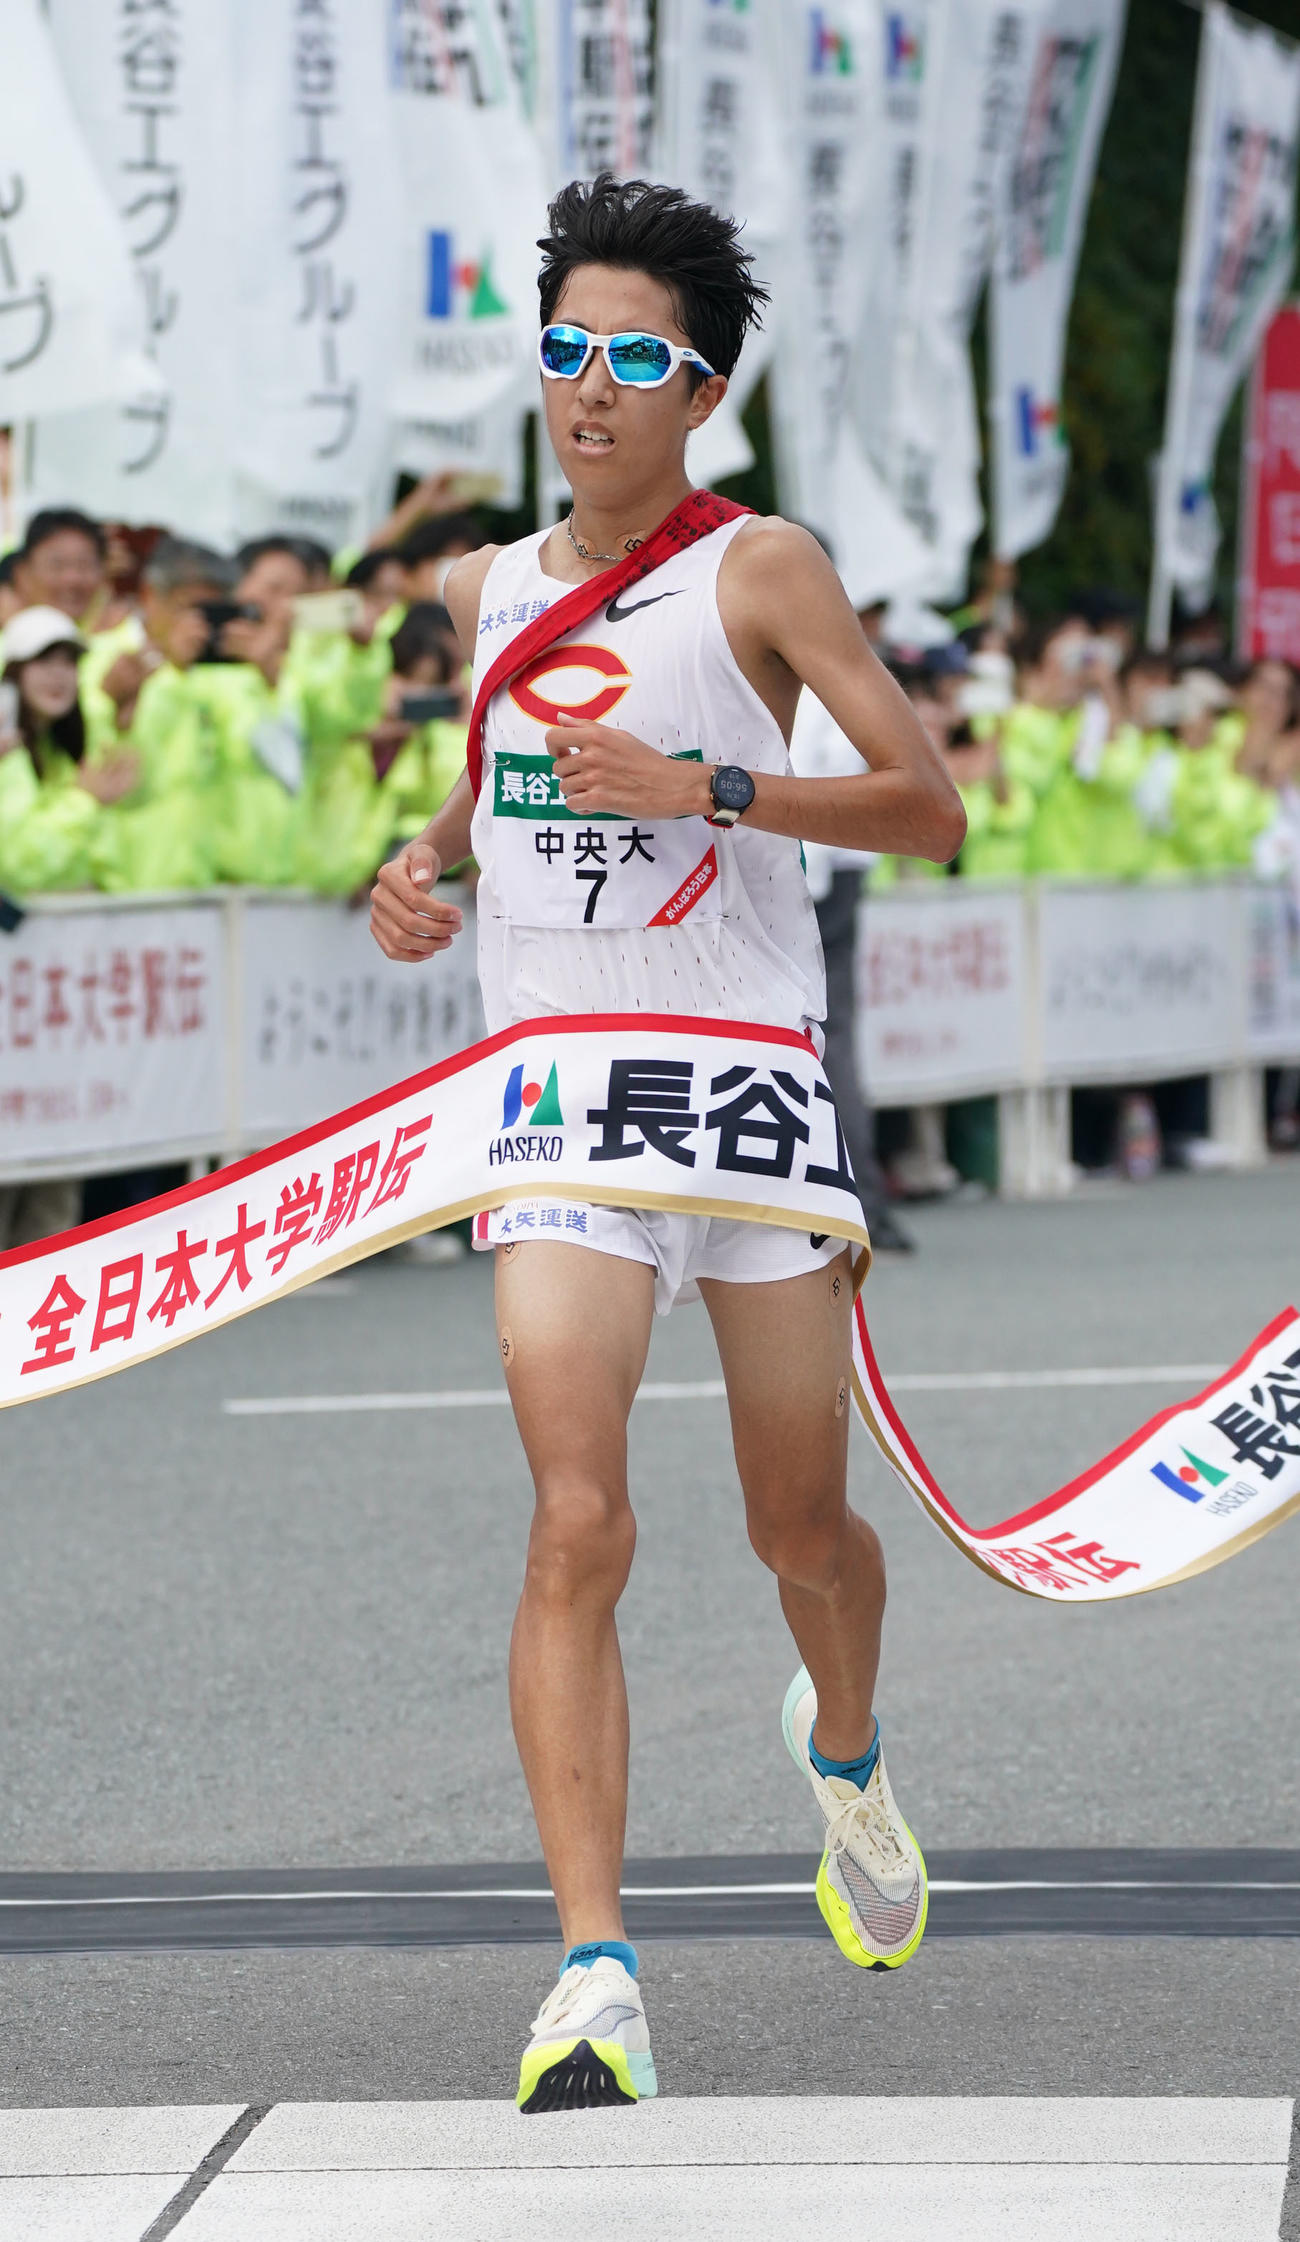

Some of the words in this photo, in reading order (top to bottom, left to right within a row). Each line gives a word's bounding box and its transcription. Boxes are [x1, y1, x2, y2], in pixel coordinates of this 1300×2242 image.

[508, 643, 633, 727] C
[535, 826, 656, 865] 中央大
[575, 869, 608, 923] 7
[665, 862, 713, 920] がんばろう日本
[489, 1136, 563, 1166] HASEKO
[587, 1059, 857, 1195] 長谷工
[20, 1113, 434, 1375] 全日本大学駅伝
[1209, 1347, 1300, 1481] 長谷
[1206, 1481, 1259, 1517] HASEKO
[985, 1531, 1141, 1591] 駅伝
